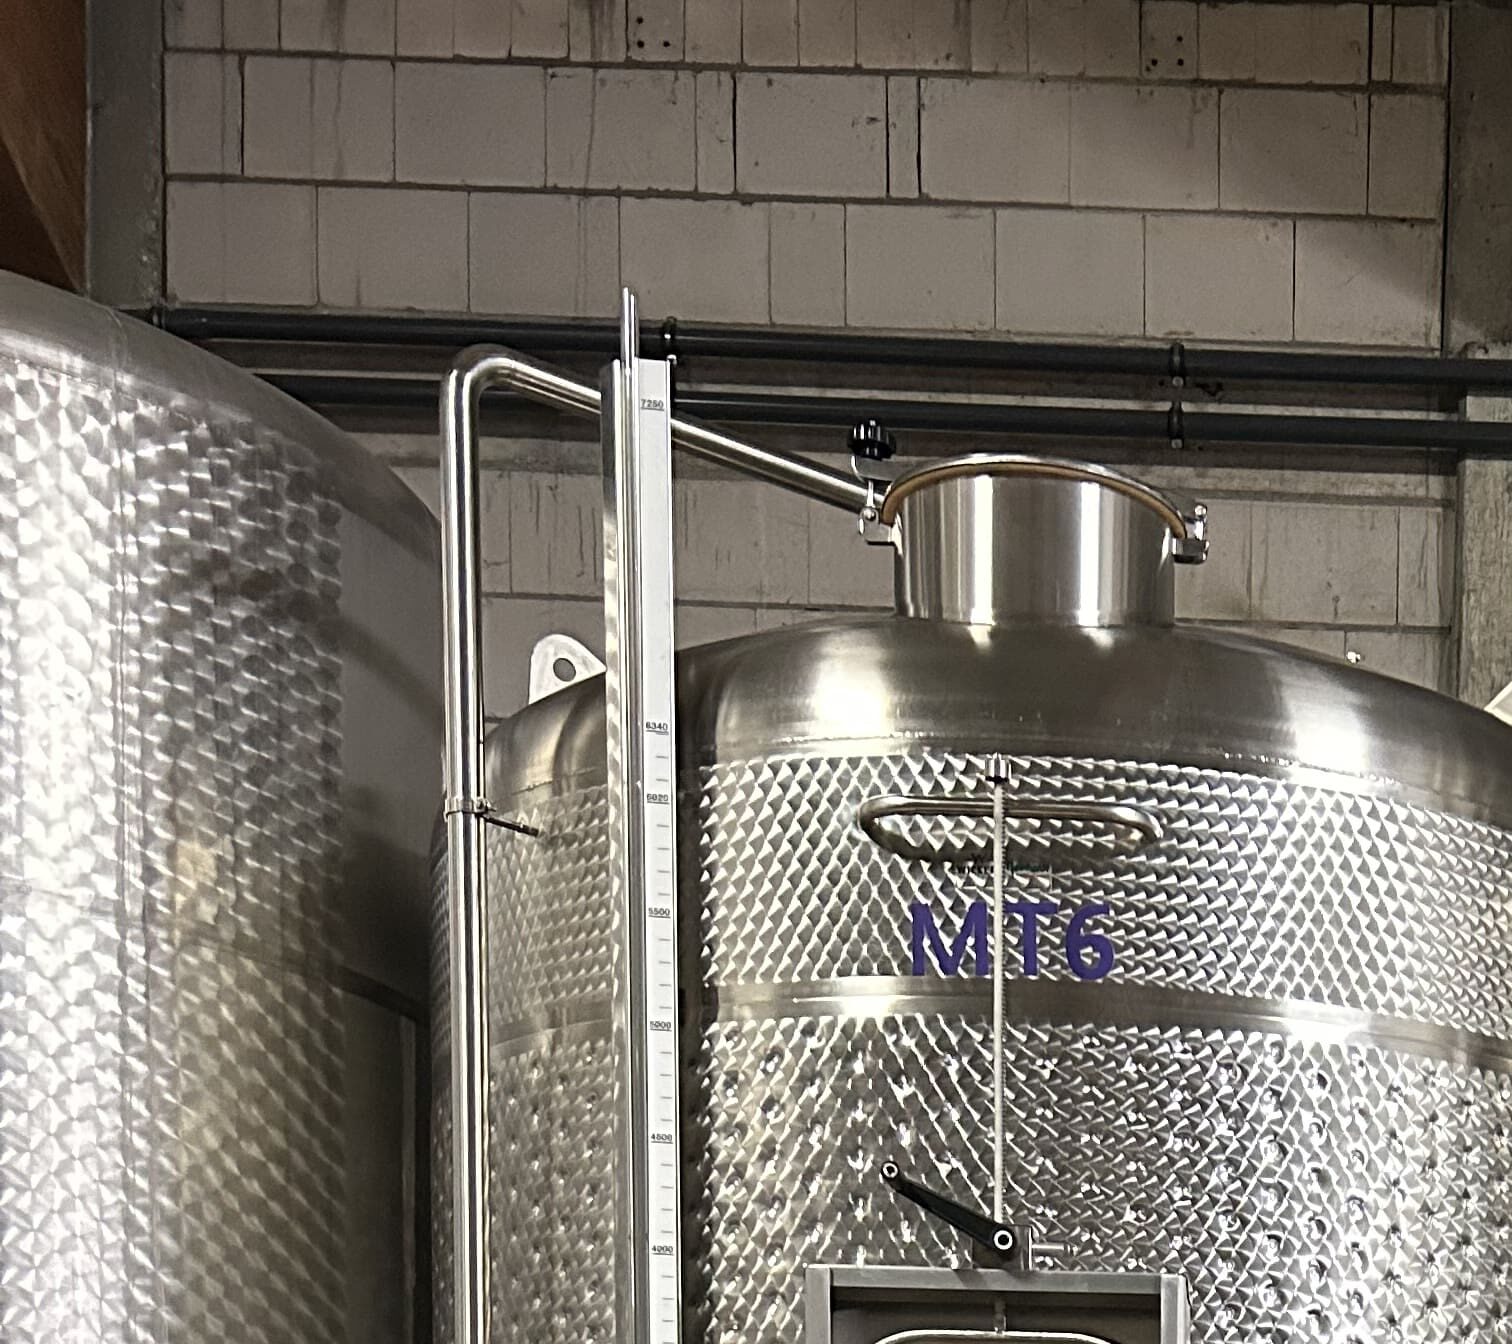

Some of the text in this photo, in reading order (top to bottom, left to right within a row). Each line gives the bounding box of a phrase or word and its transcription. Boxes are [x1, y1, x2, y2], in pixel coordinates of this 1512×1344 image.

[648, 907, 671, 916] 5500
[910, 901, 1114, 980] MT6
[649, 1020, 672, 1029] 5000
[650, 1133, 673, 1142] 4500
[651, 1245, 674, 1254] 4000
